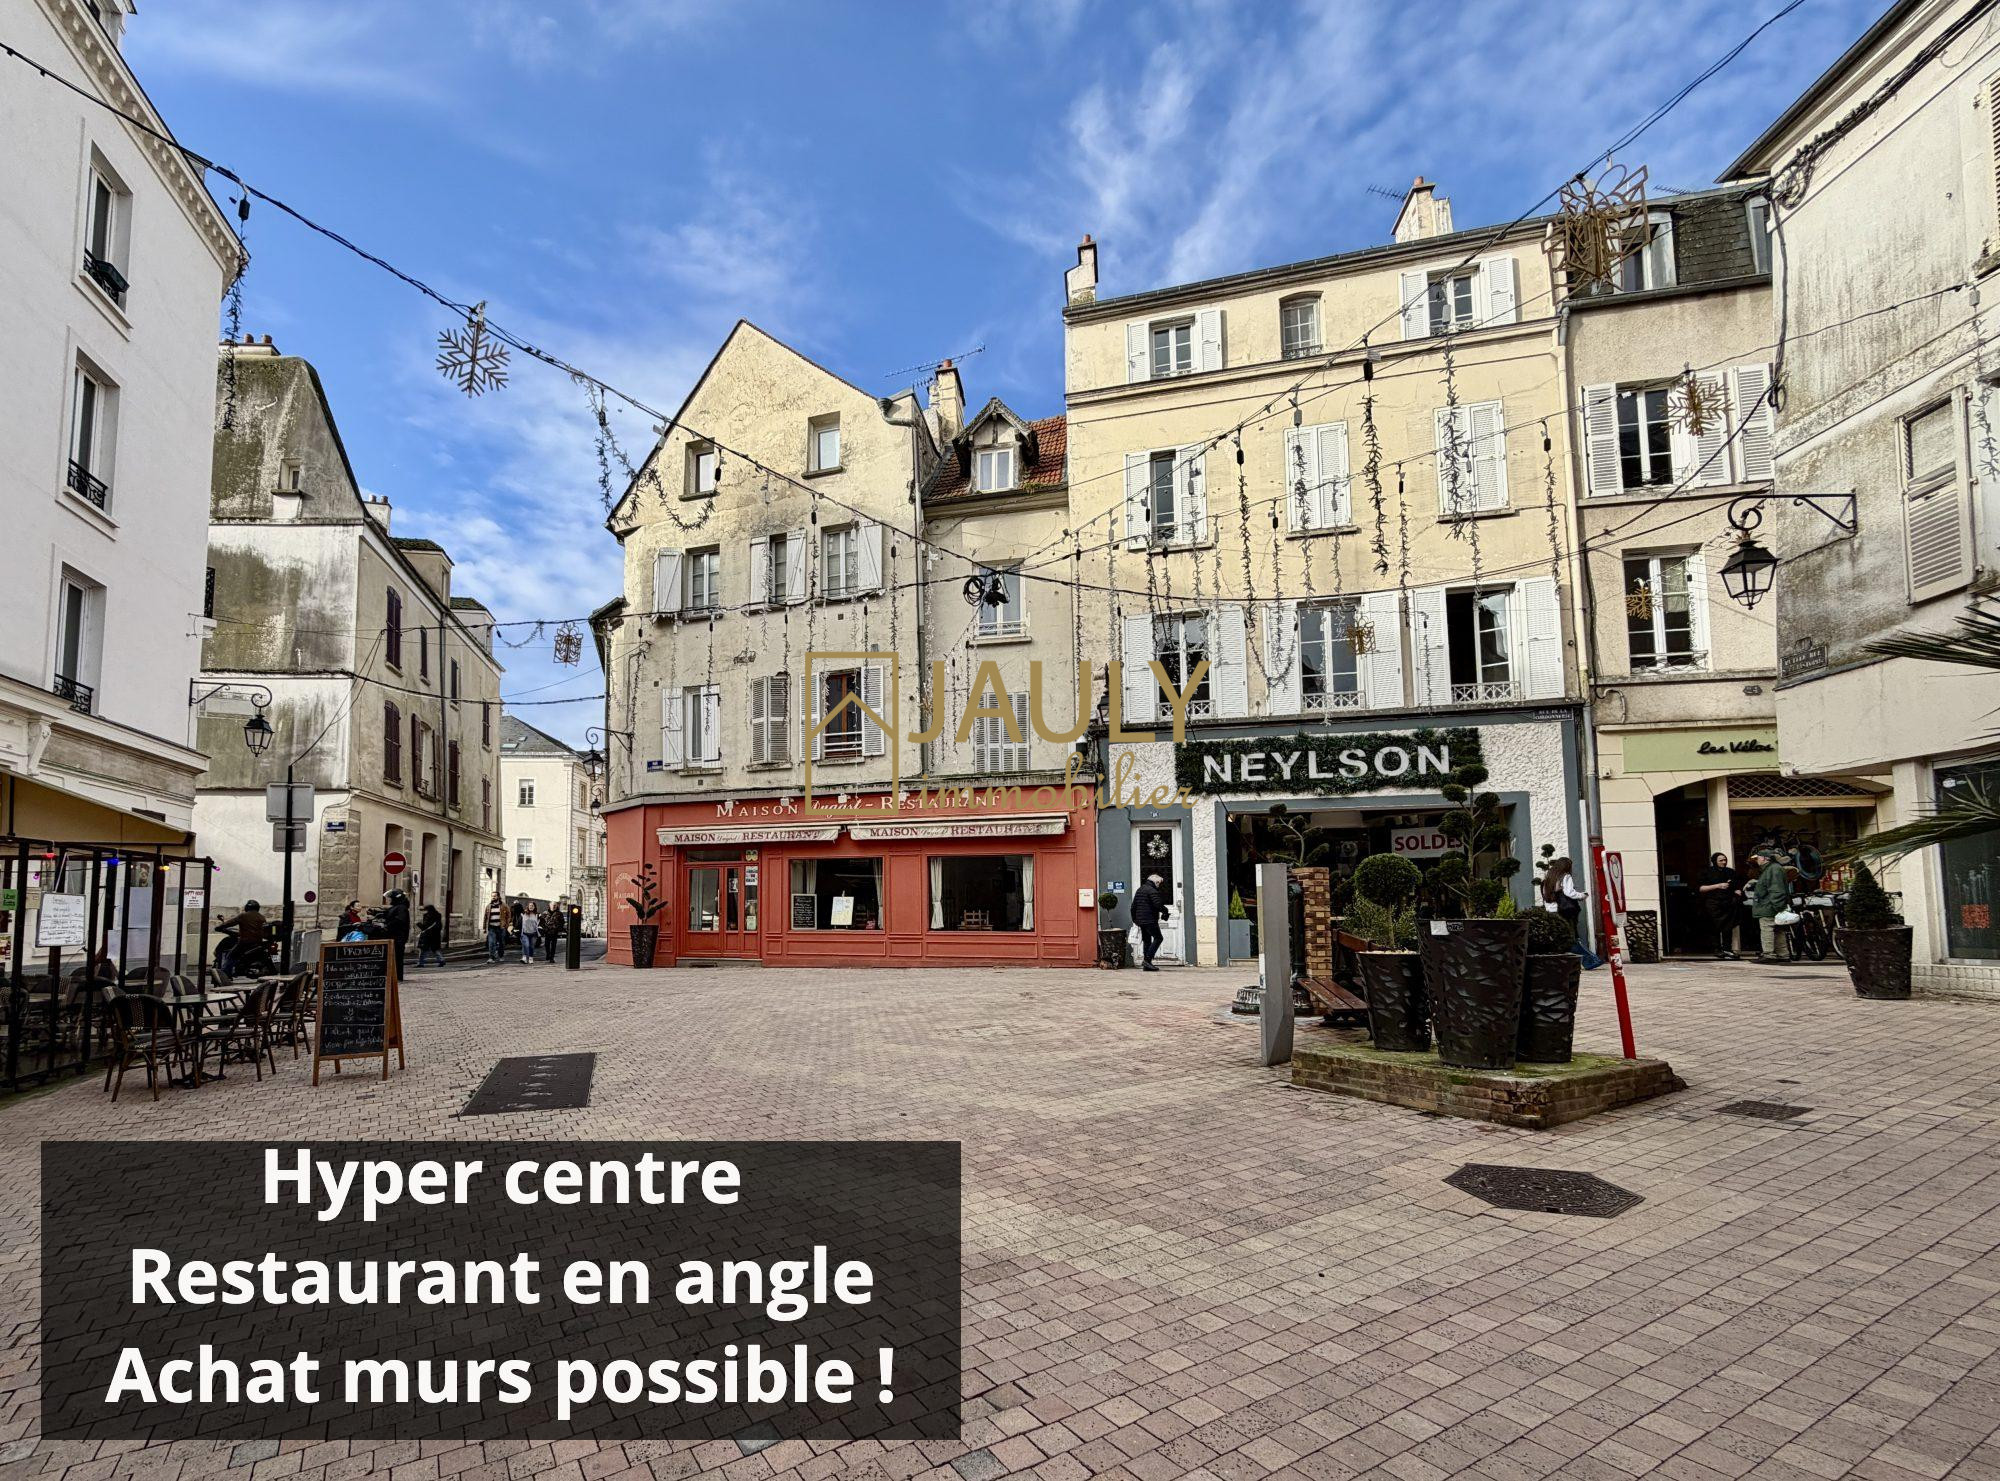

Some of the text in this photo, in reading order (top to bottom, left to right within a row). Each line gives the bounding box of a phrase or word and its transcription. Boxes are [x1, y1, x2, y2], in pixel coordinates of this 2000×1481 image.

[1203, 745, 1450, 783] NEYLSON
[716, 804, 798, 817] MAISON
[870, 827, 918, 837] MAISON
[674, 833, 716, 843] MAISON
